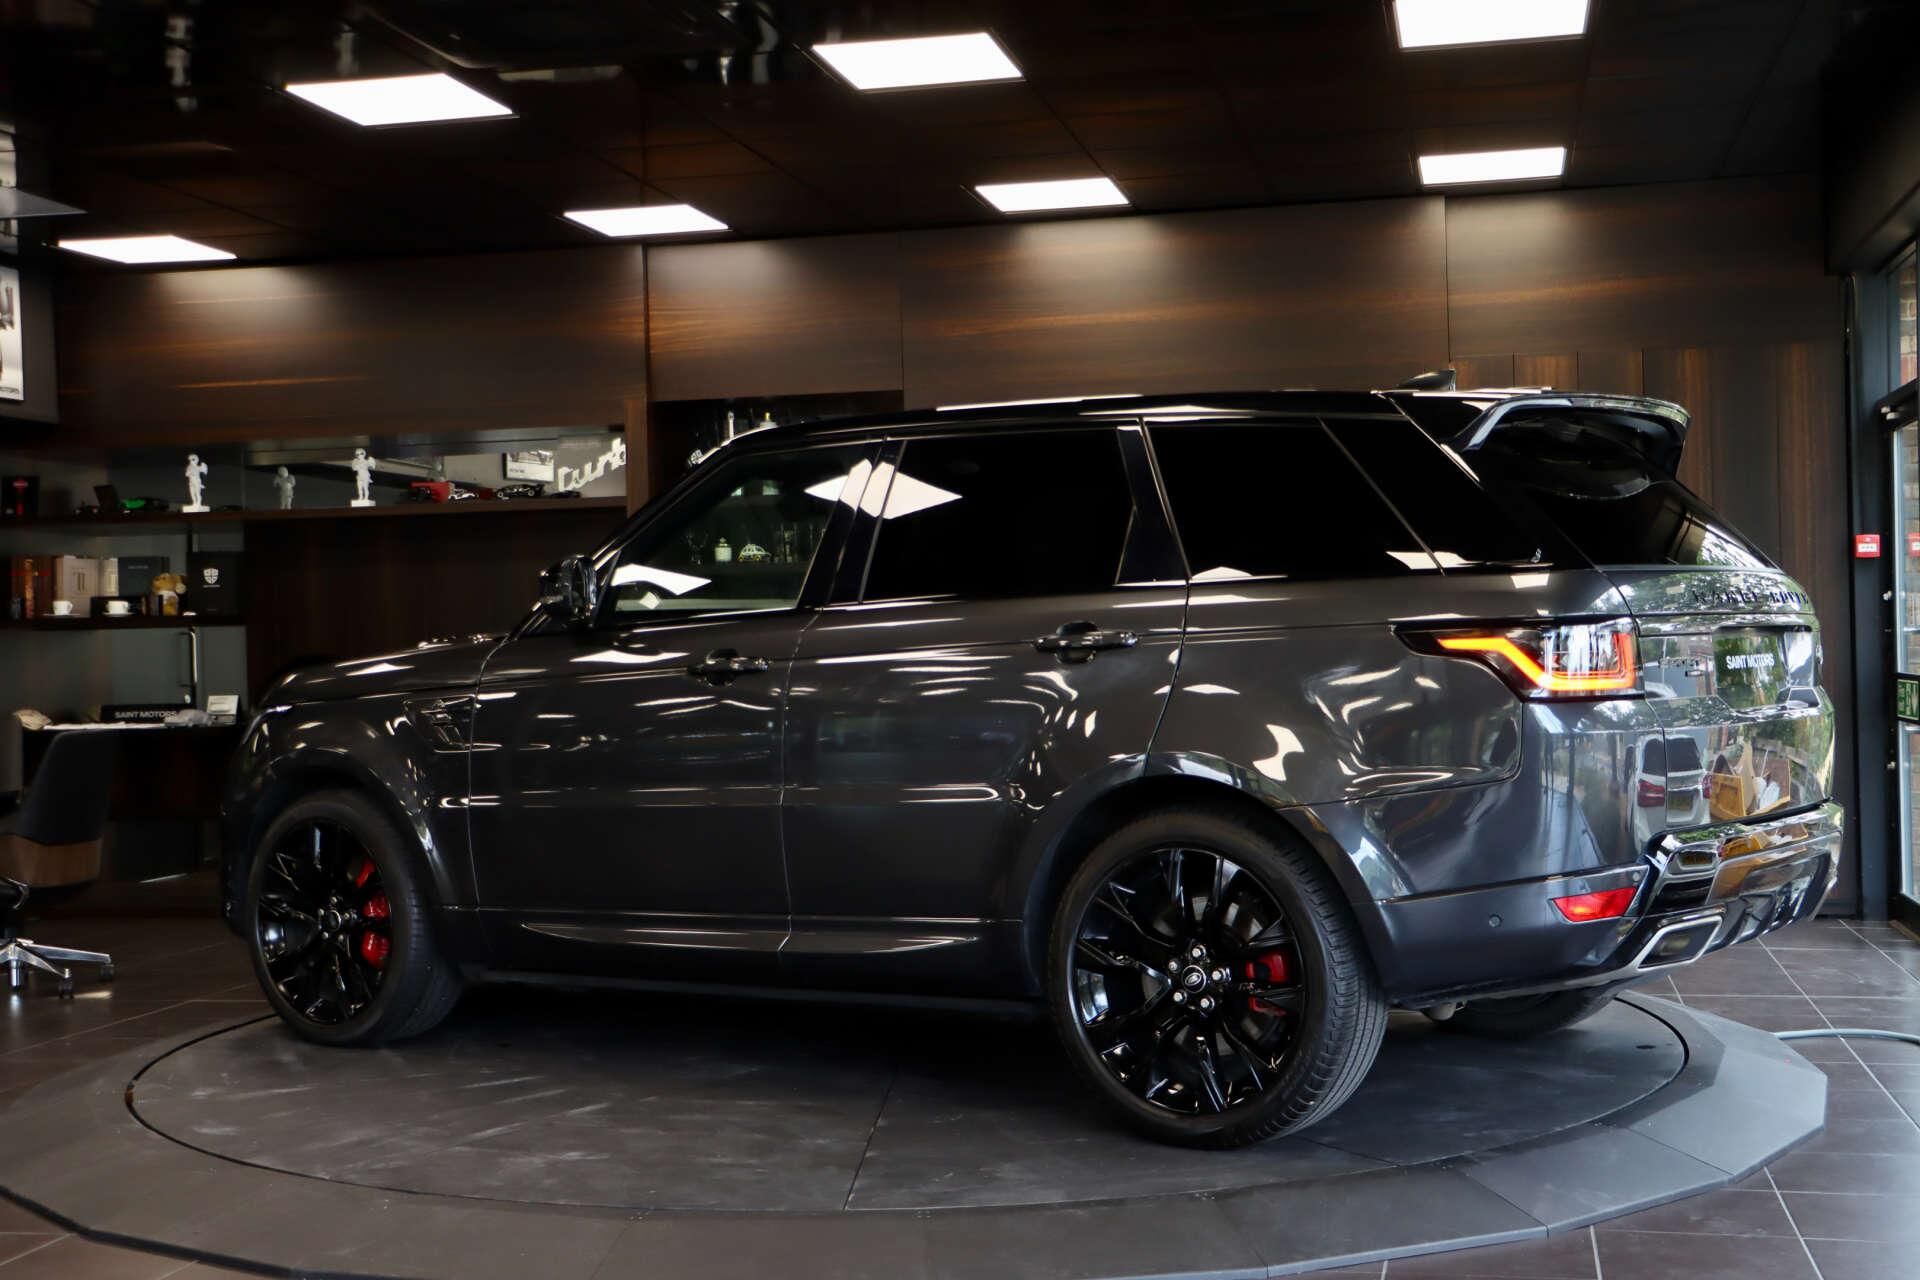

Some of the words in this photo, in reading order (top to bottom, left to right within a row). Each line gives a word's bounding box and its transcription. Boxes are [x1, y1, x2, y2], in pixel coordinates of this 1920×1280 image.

[1726, 655, 1747, 670] SAINT
[1747, 653, 1775, 668] MOTORS
[115, 711, 139, 719] SAINT
